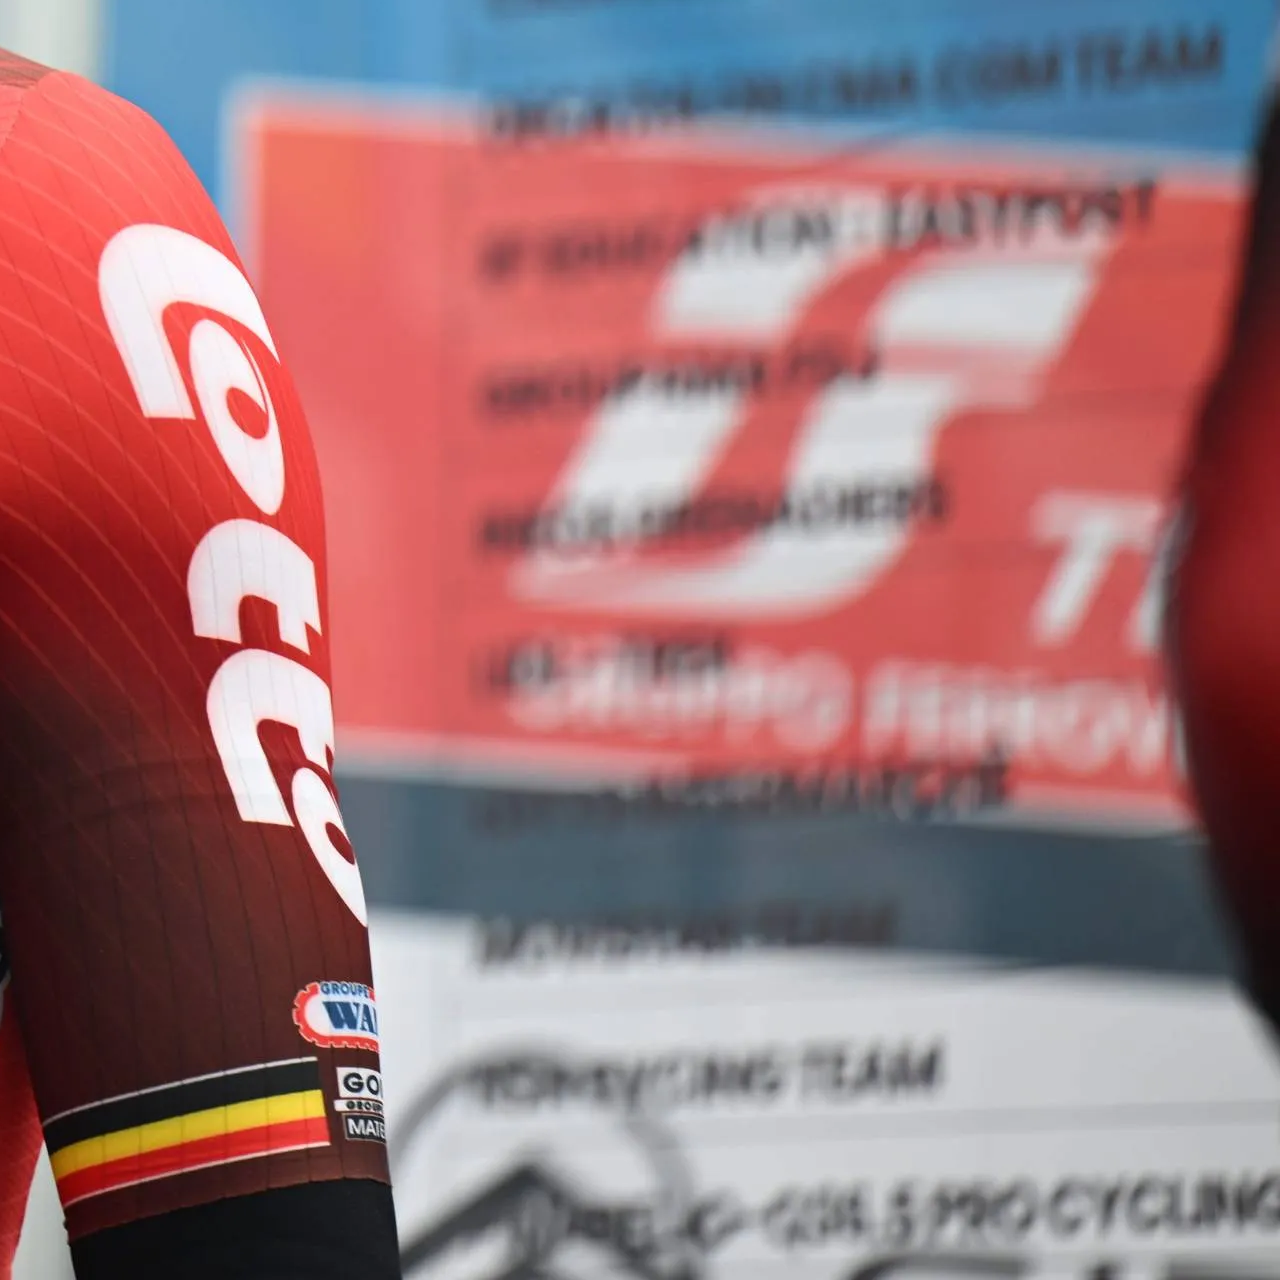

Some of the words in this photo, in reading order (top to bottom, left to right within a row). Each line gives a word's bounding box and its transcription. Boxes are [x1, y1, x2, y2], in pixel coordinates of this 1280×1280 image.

[320, 981, 369, 998] GROUPE
[321, 1000, 378, 1035] WA
[342, 1071, 383, 1097] GO
[346, 1117, 386, 1138] MATE
